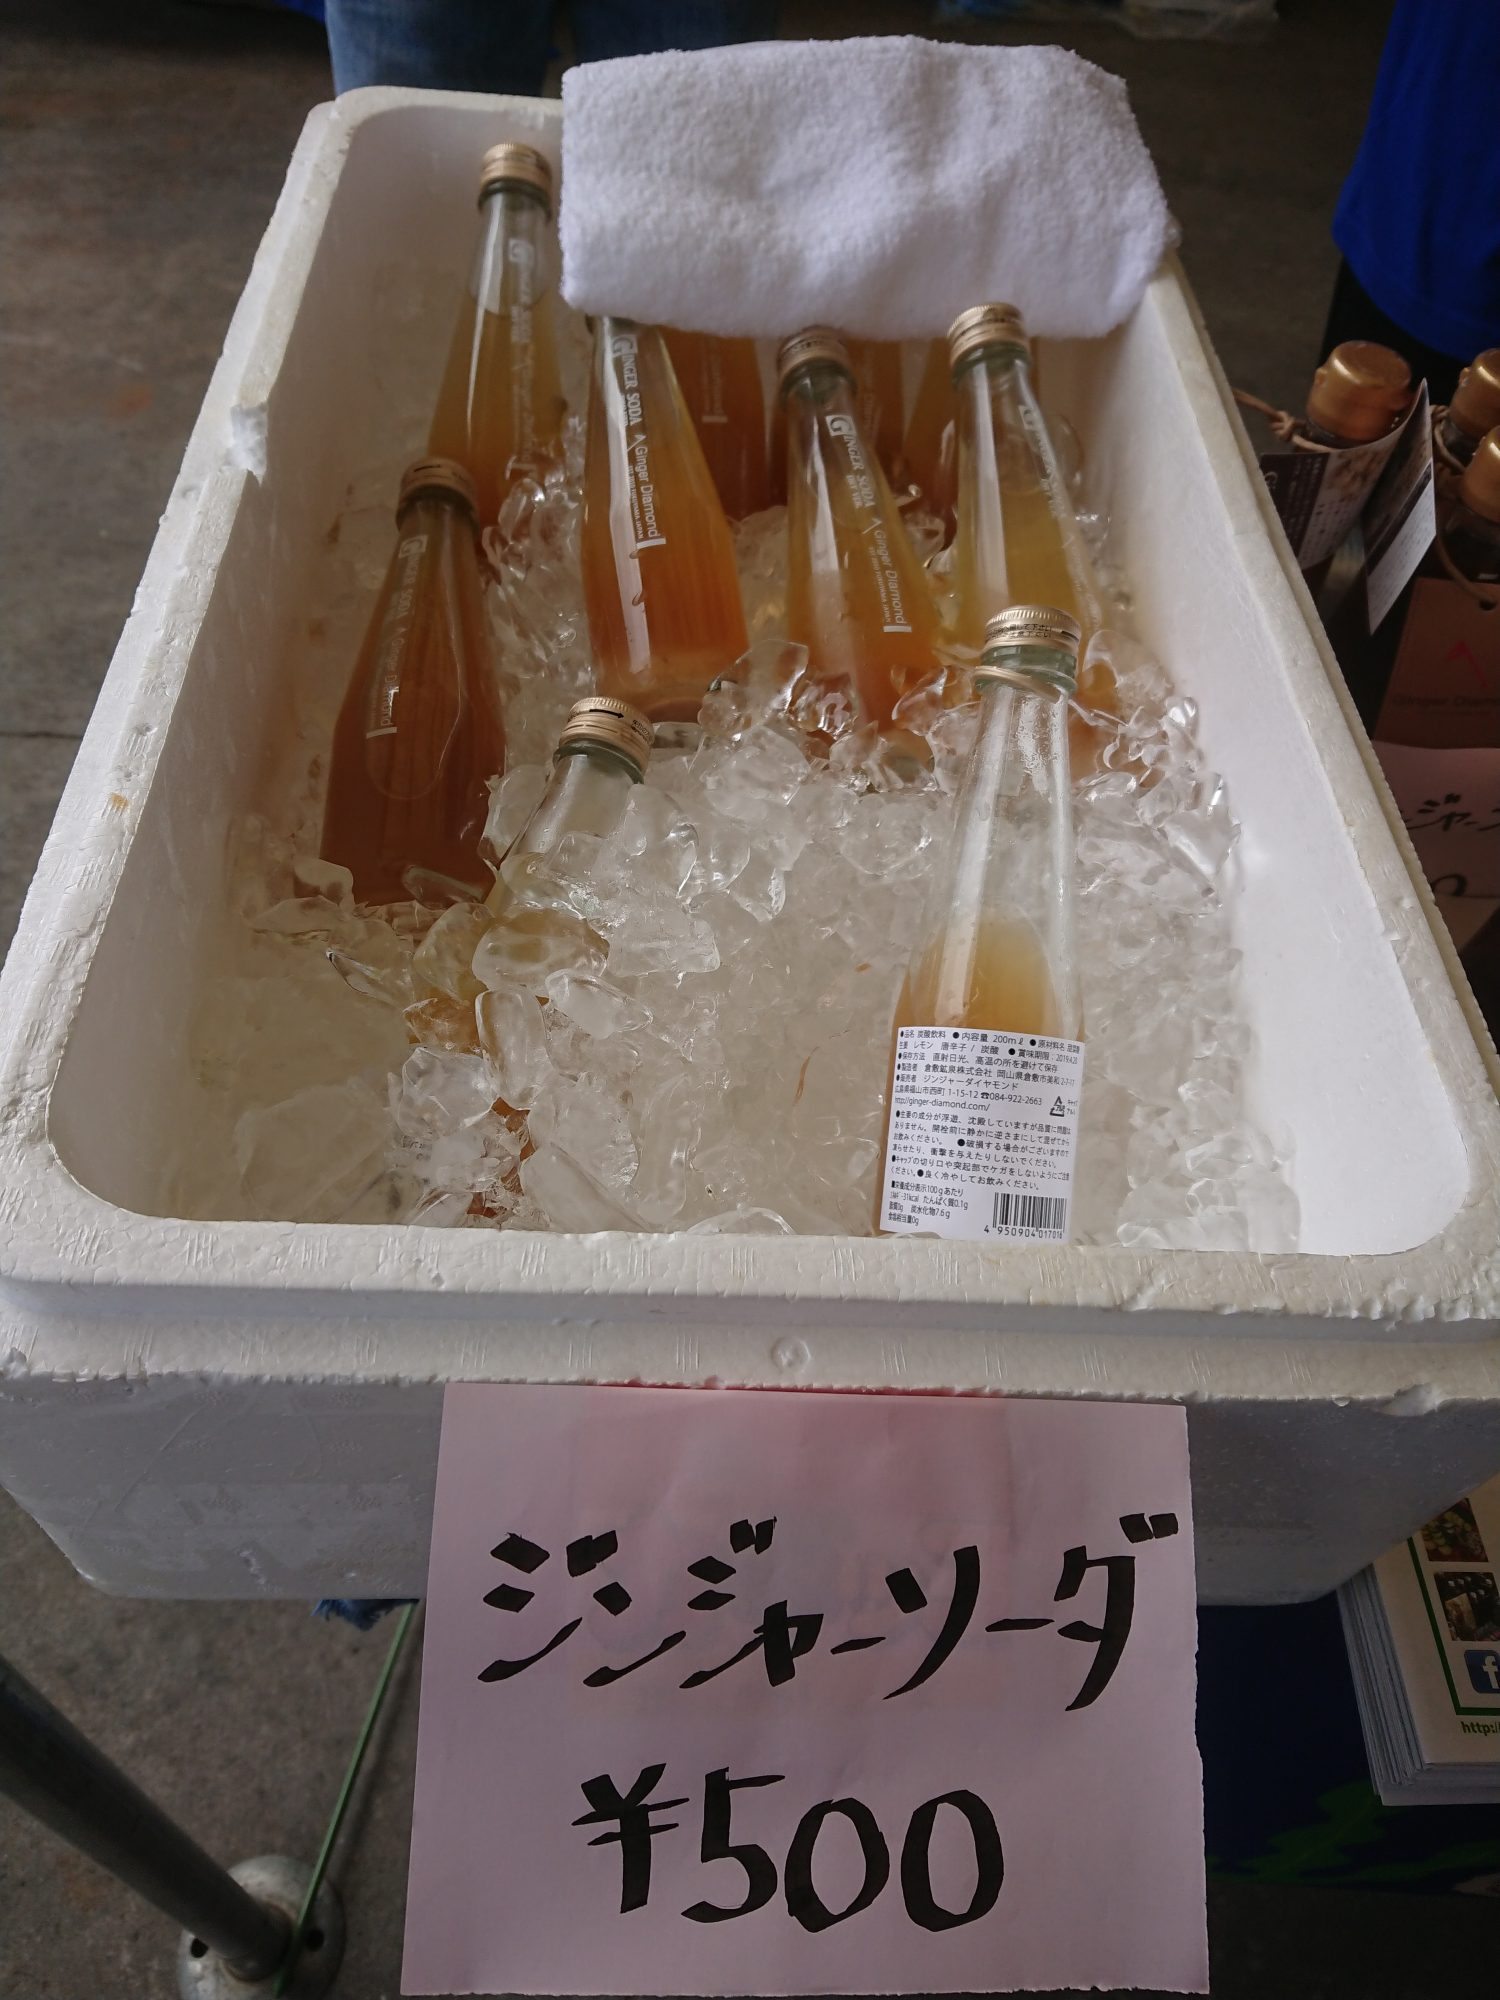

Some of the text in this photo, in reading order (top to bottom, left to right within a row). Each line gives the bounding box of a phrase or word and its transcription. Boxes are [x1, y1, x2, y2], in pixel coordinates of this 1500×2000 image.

[609, 334, 643, 426] GINGER SODA
[825, 414, 876, 508] GINGER SODA
[635, 447, 661, 538] Ginger Diamond
[874, 530, 907, 624] Ginger Diamond
[917, 1030, 946, 1039] 炭酸飲料
[961, 1032, 988, 1042] 内容量
[914, 1041, 934, 1050] レモン
[940, 1042, 967, 1052] 唐辛子
[981, 1045, 999, 1055] 炭酸
[1037, 1039, 1065, 1052] 原材料名
[902, 1052, 925, 1061] 保存方法
[1018, 1048, 1050, 1060] 賞味期限
[901, 1063, 918, 1072] 製造者
[923, 1075, 1019, 1091] ジンジャーダイヤモンド
[948, 1089, 979, 1099] 1-15-12
[894, 1096, 990, 1112] http://ginger-diamond.com/
[925, 1170, 1039, 1190] 良く冷やしてお飲みください。
[477, 1512, 1179, 1711] ジンジャーソーダ
[571, 1763, 1004, 1933] ¥500
